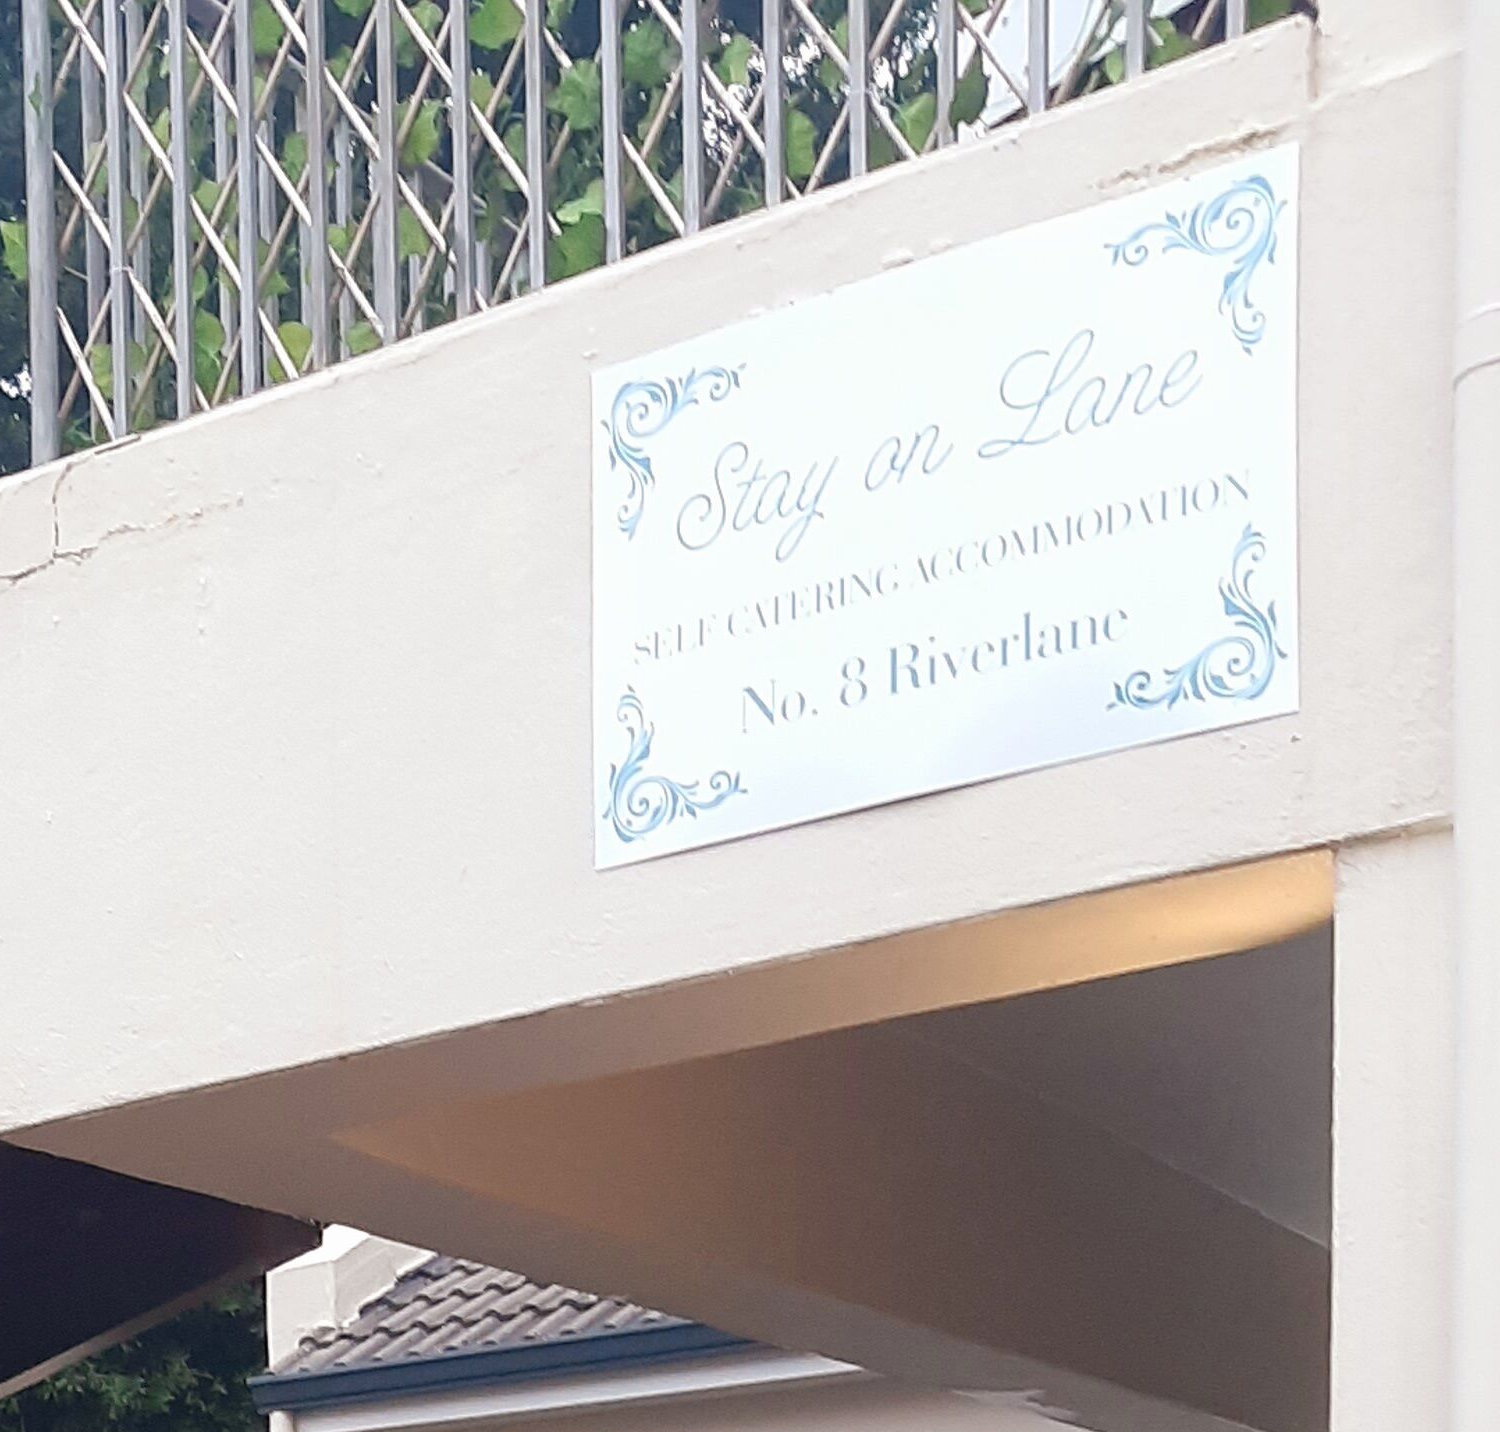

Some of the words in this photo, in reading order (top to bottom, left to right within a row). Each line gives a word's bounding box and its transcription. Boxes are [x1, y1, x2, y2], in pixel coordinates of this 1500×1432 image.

[676, 441, 839, 563] Stay
[864, 424, 953, 493] on
[977, 328, 1203, 459] Lane
[633, 613, 713, 666] SELF
[727, 560, 900, 639] CATERING
[914, 469, 1251, 586] ACCOMMODATION
[741, 676, 819, 734] No.
[839, 656, 868, 706] 8
[888, 604, 1130, 697] Riverlane
